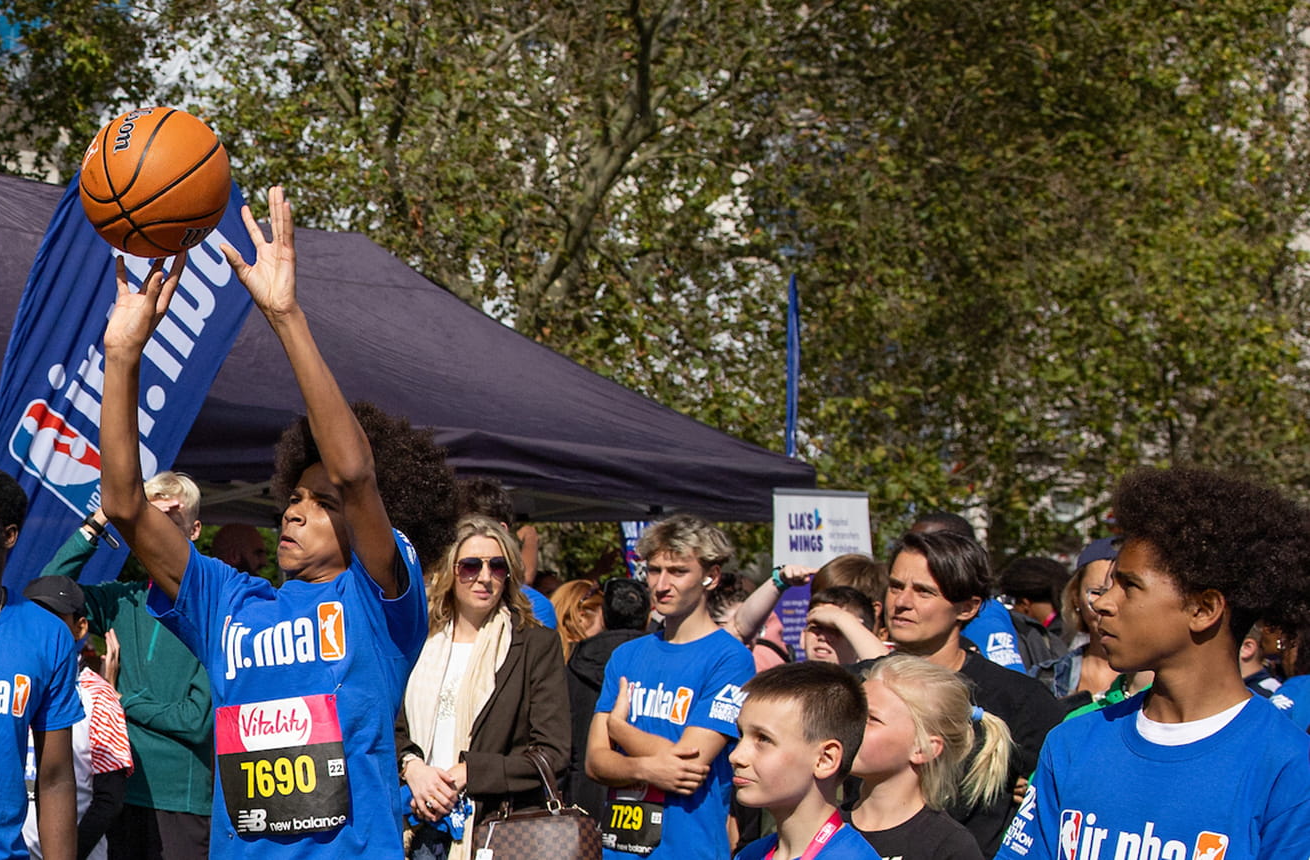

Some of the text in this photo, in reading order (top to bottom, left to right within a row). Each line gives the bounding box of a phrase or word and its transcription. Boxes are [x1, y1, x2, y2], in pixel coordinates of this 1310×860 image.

[789, 512, 813, 531] LIA'S
[789, 535, 823, 553] WINGS
[241, 706, 308, 741] Vitality
[240, 754, 317, 799] 7690
[329, 764, 343, 774] 22
[270, 820, 292, 832] new
[292, 815, 347, 831] balance
[610, 804, 644, 831] 7729
